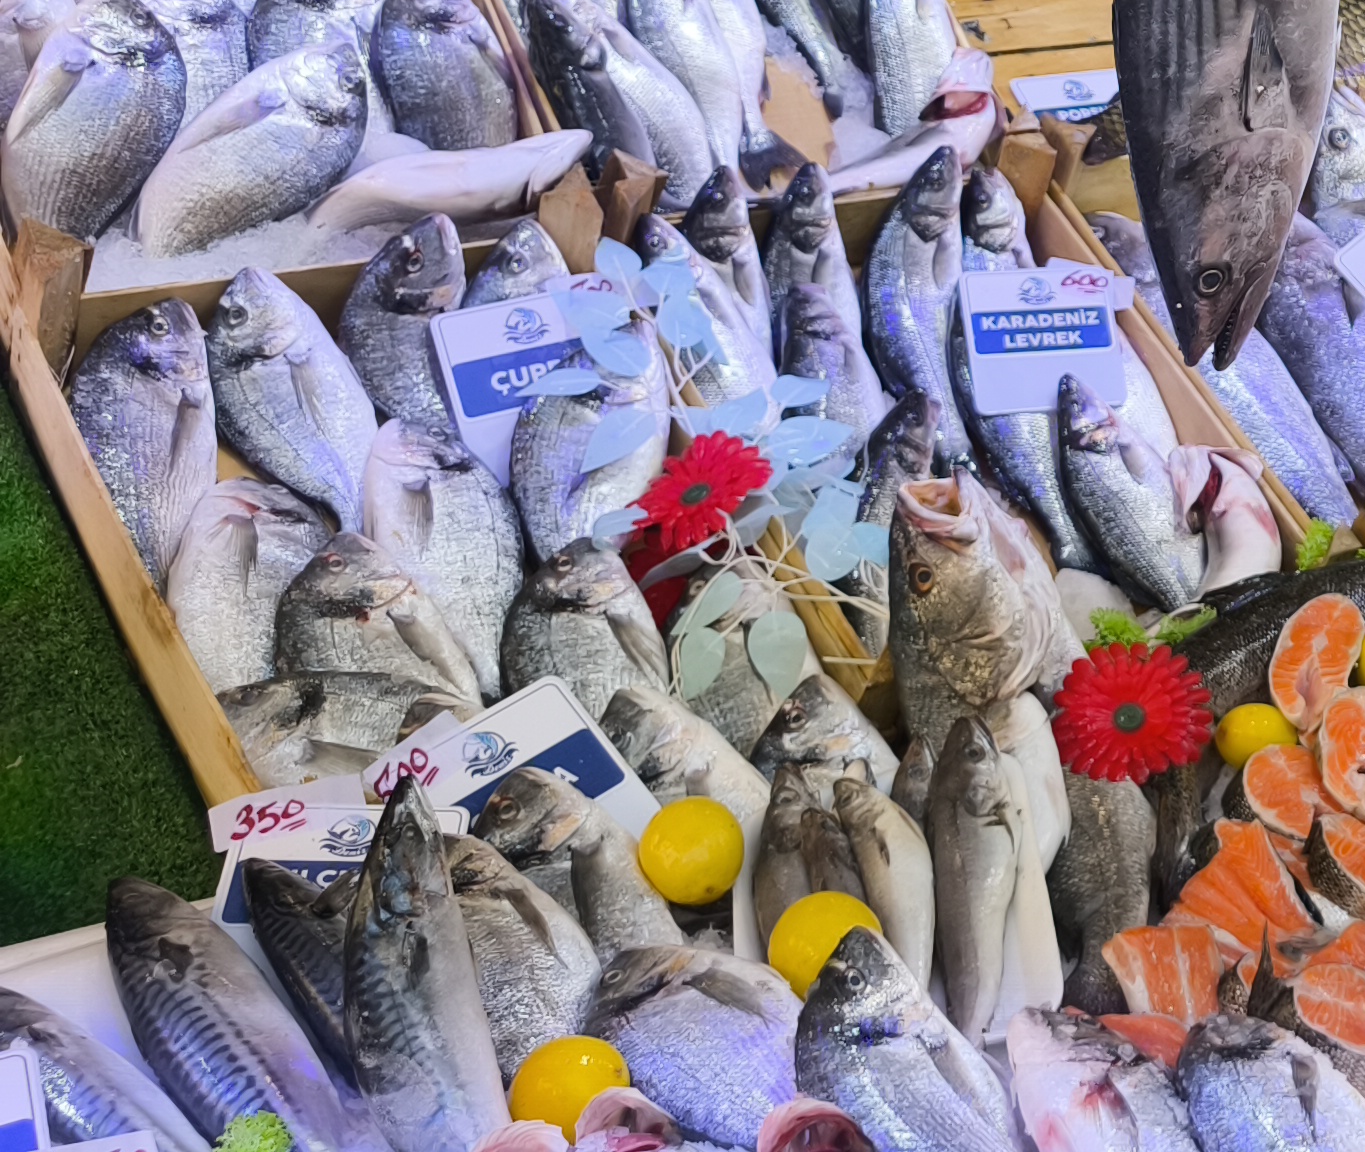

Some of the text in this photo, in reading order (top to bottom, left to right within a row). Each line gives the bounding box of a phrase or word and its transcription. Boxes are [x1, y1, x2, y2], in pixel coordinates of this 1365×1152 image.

[981, 308, 1100, 331] KARADENİZ
[1003, 331, 1084, 349] LEVREK
[231, 799, 305, 841] 350
